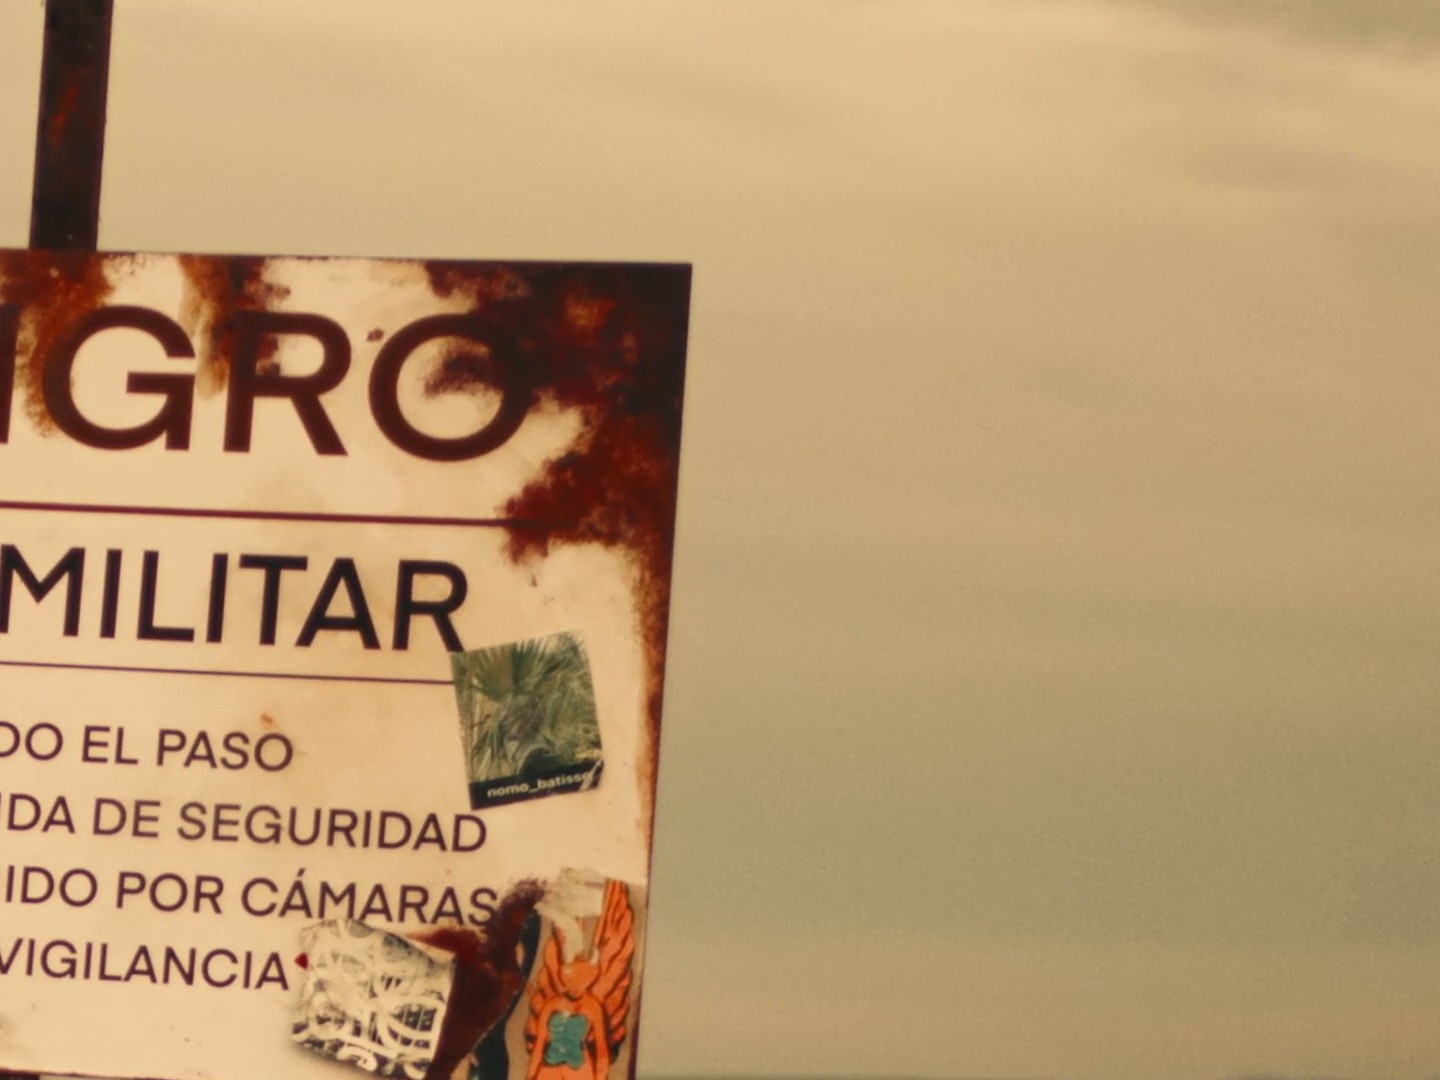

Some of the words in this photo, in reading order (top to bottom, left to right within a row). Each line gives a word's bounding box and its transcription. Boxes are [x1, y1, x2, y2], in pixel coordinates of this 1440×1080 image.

[81, 724, 139, 765] EL
[155, 728, 294, 773] PASO
[92, 797, 161, 839] DE
[176, 801, 487, 853] SEGURIDAD
[115, 871, 224, 915] POR
[241, 869, 497, 928] CÁMARAS
